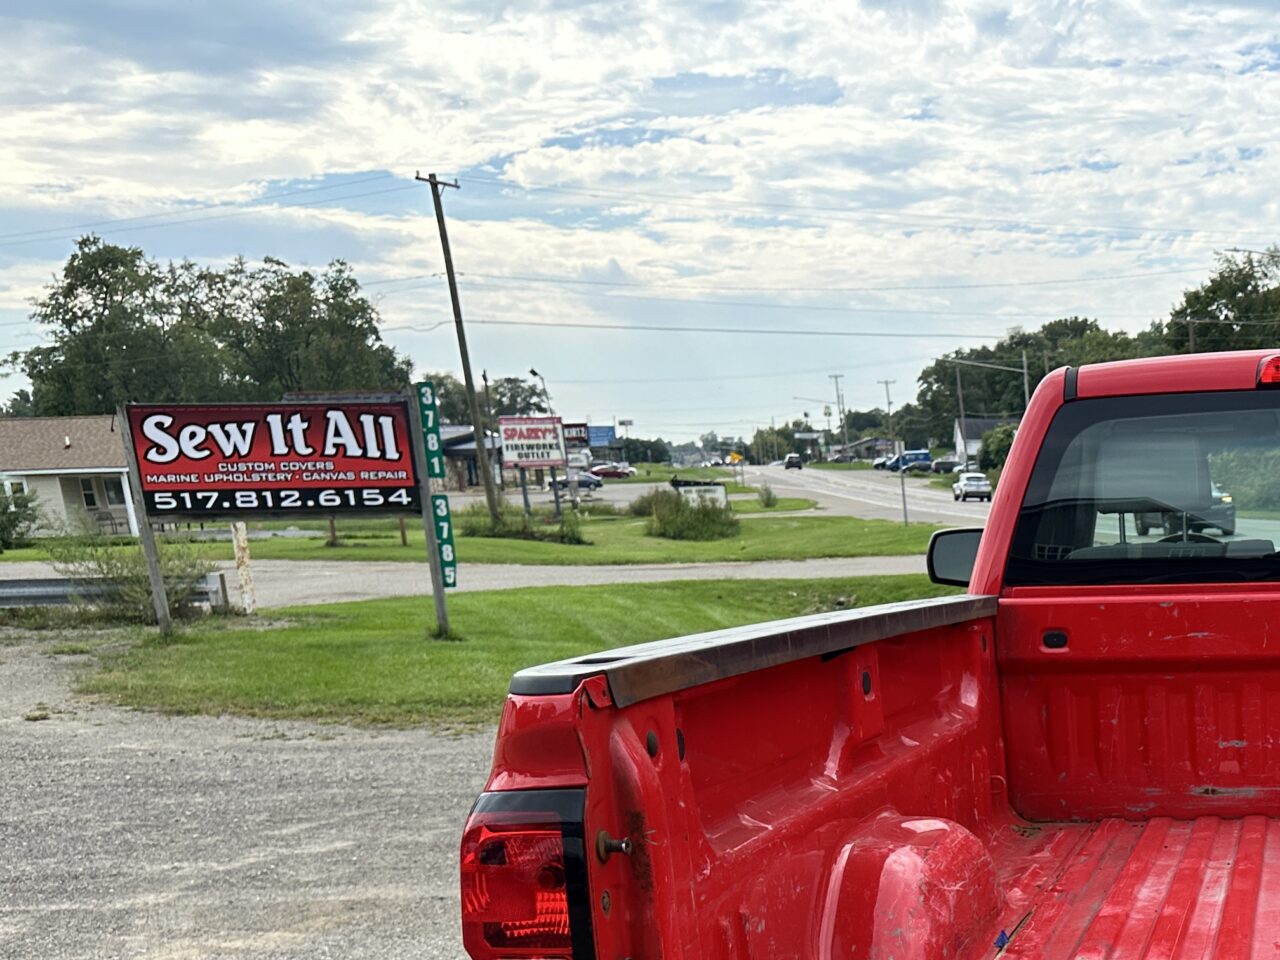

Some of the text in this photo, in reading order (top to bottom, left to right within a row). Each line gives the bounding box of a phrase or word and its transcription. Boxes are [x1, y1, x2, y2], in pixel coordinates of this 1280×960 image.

[142, 409, 401, 463] Sew It All
[420, 386, 440, 474] 3781
[505, 442, 561, 452] FIREWORKS
[517, 451, 551, 459] OUTLET
[217, 461, 335, 472] CUSTOM COVERS
[146, 470, 407, 483] MARINE UPHOLSTERY CANVAS REPAIR
[153, 488, 413, 509] 517.812.6154
[434, 499, 456, 583] 3785
